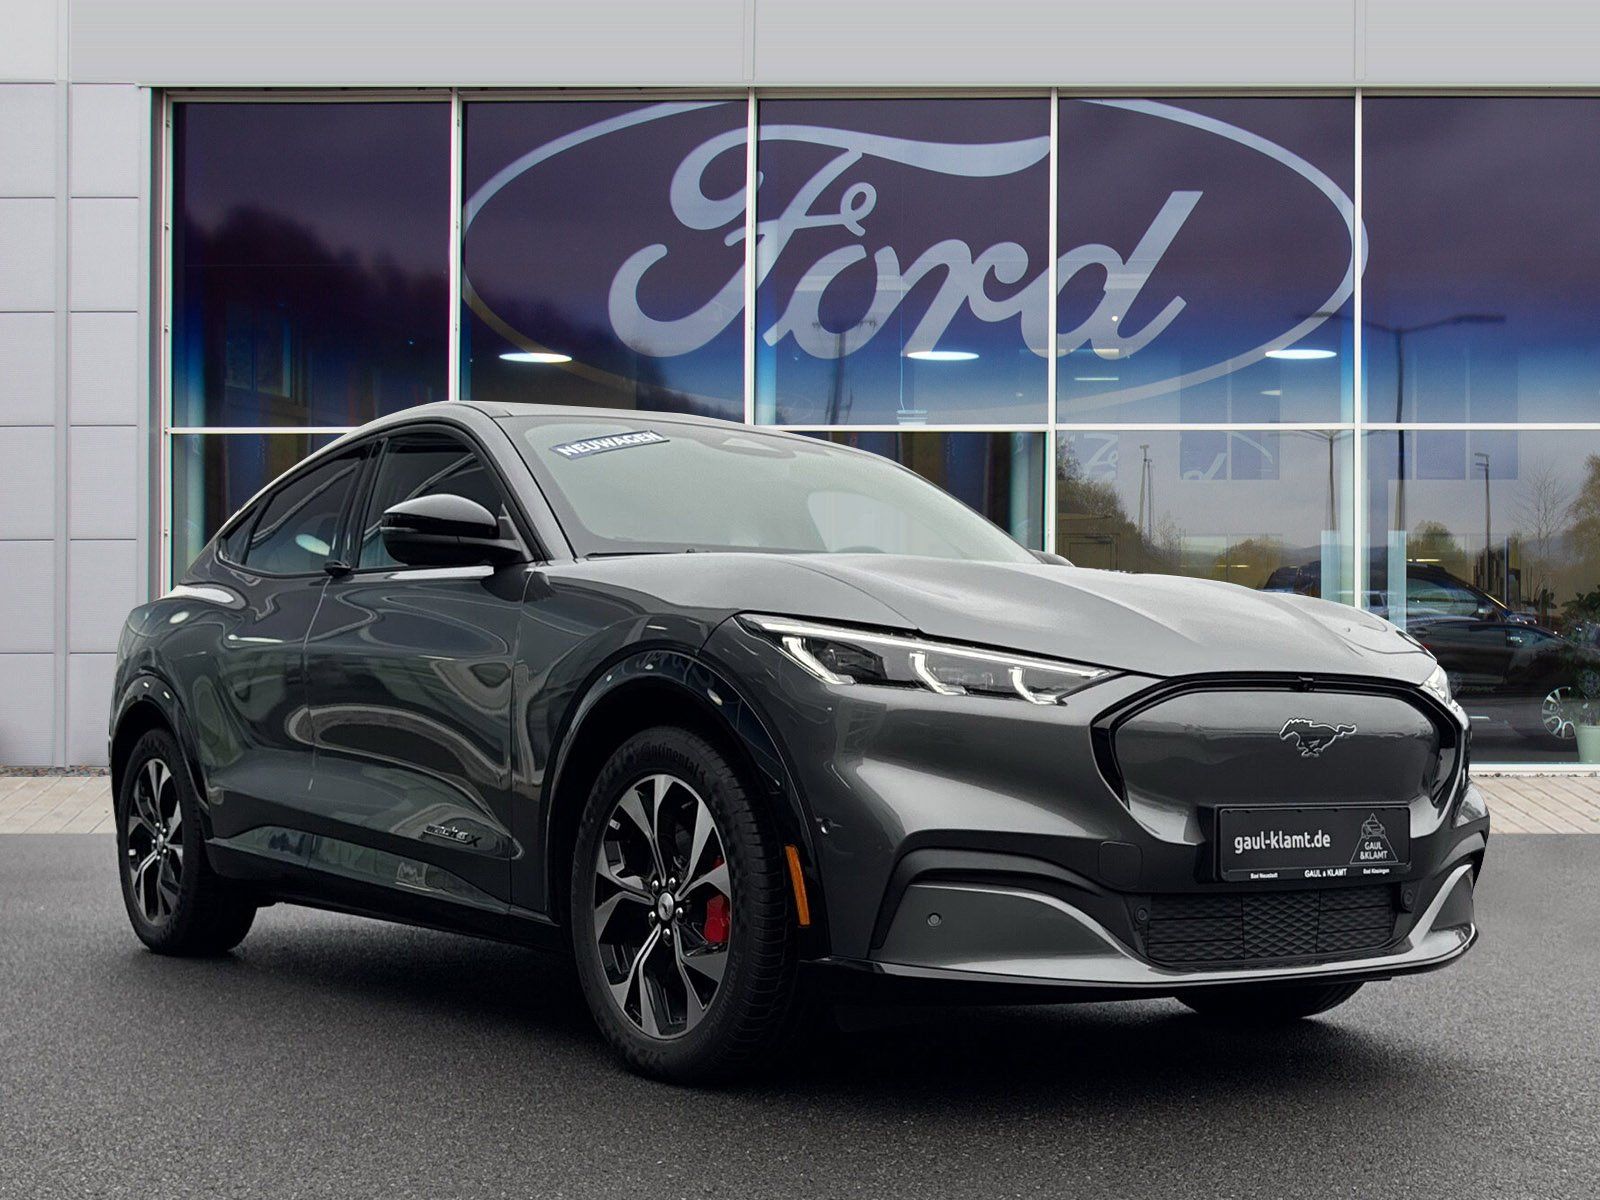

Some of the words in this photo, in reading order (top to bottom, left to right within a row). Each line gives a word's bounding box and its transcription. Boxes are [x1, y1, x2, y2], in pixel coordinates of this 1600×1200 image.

[608, 124, 1204, 360] Ford
[556, 430, 664, 456] NEUWAGEN
[1234, 829, 1331, 854] gaul-klamt.de
[1364, 841, 1383, 850] GAUL
[1304, 869, 1322, 878] GAUL
[1327, 868, 1348, 878] KLAMT
